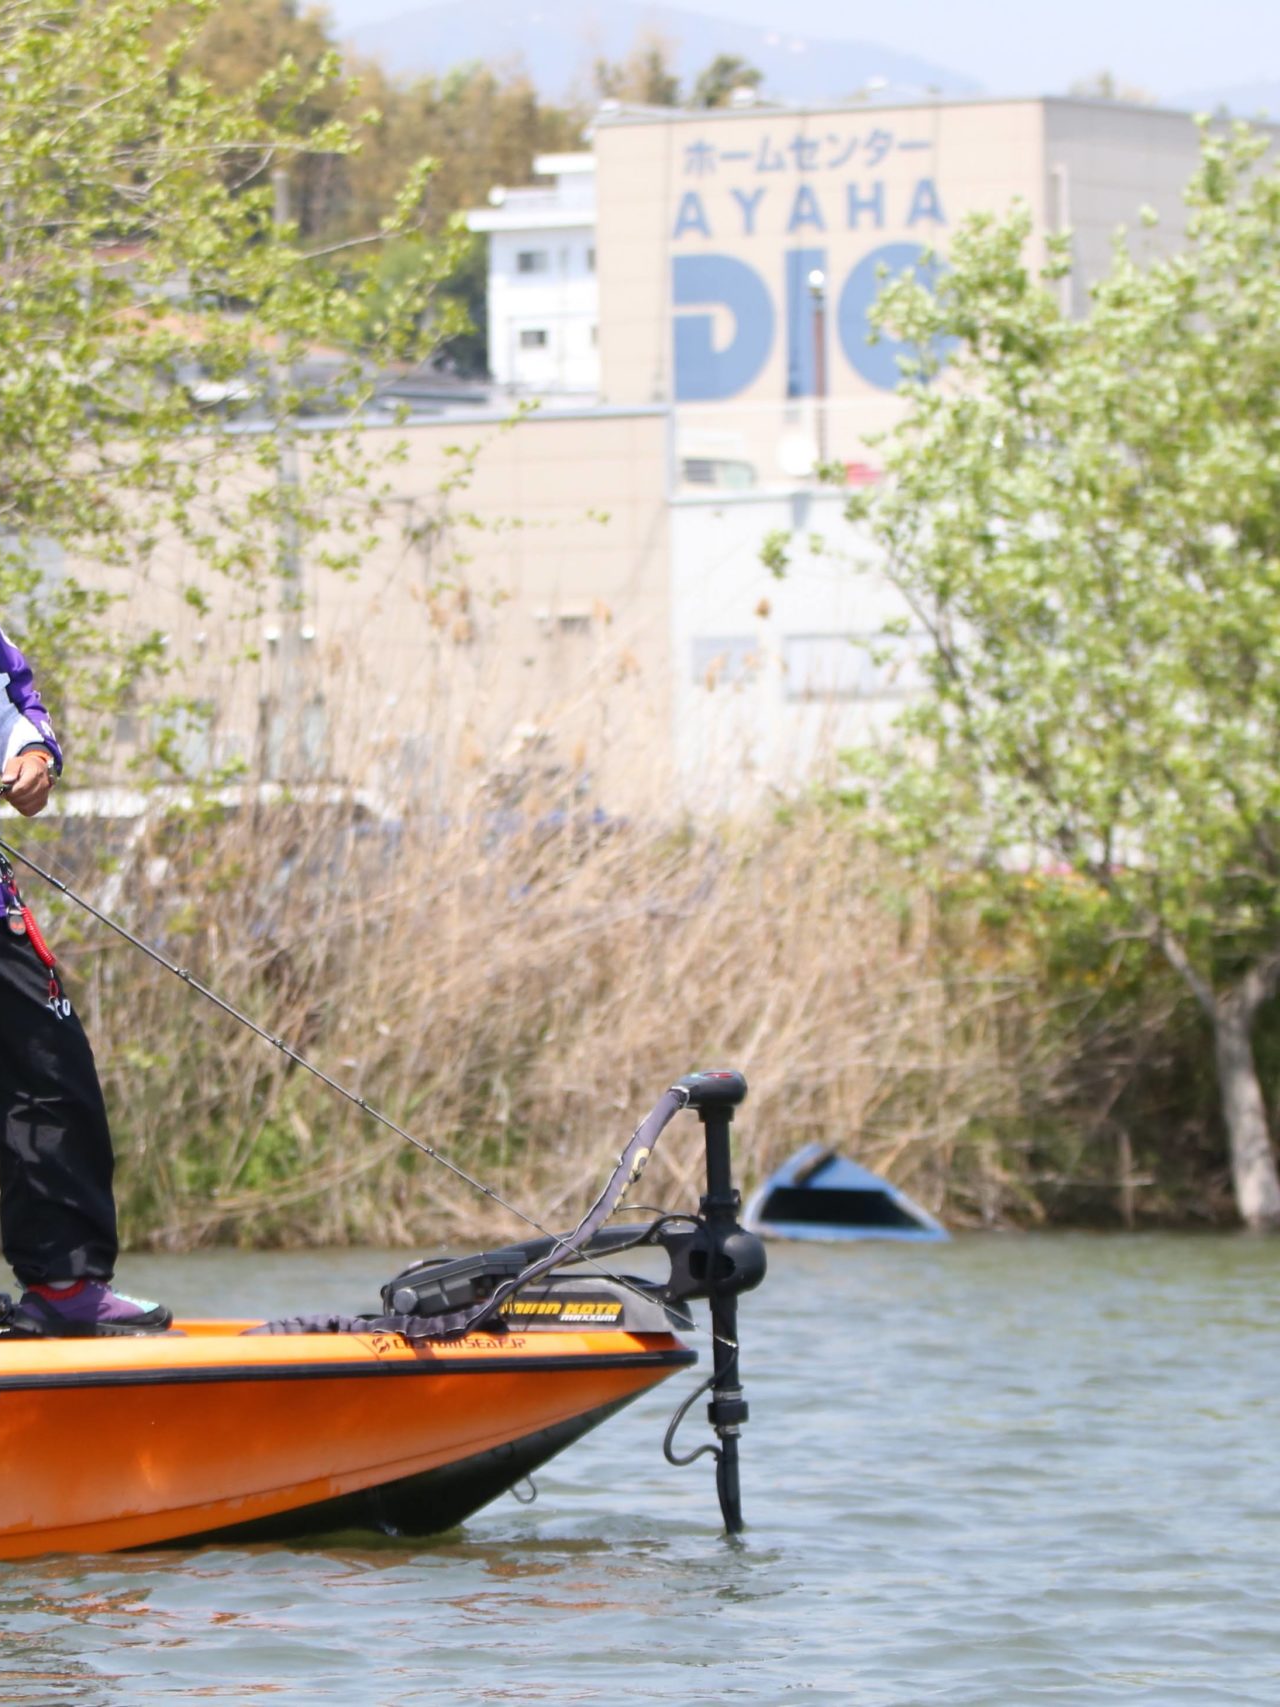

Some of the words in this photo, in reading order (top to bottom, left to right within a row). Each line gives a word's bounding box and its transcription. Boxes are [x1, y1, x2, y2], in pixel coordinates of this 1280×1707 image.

[684, 129, 933, 177] ホームセンター
[672, 178, 947, 240] AYAHA
[563, 1302, 623, 1315] KOTA
